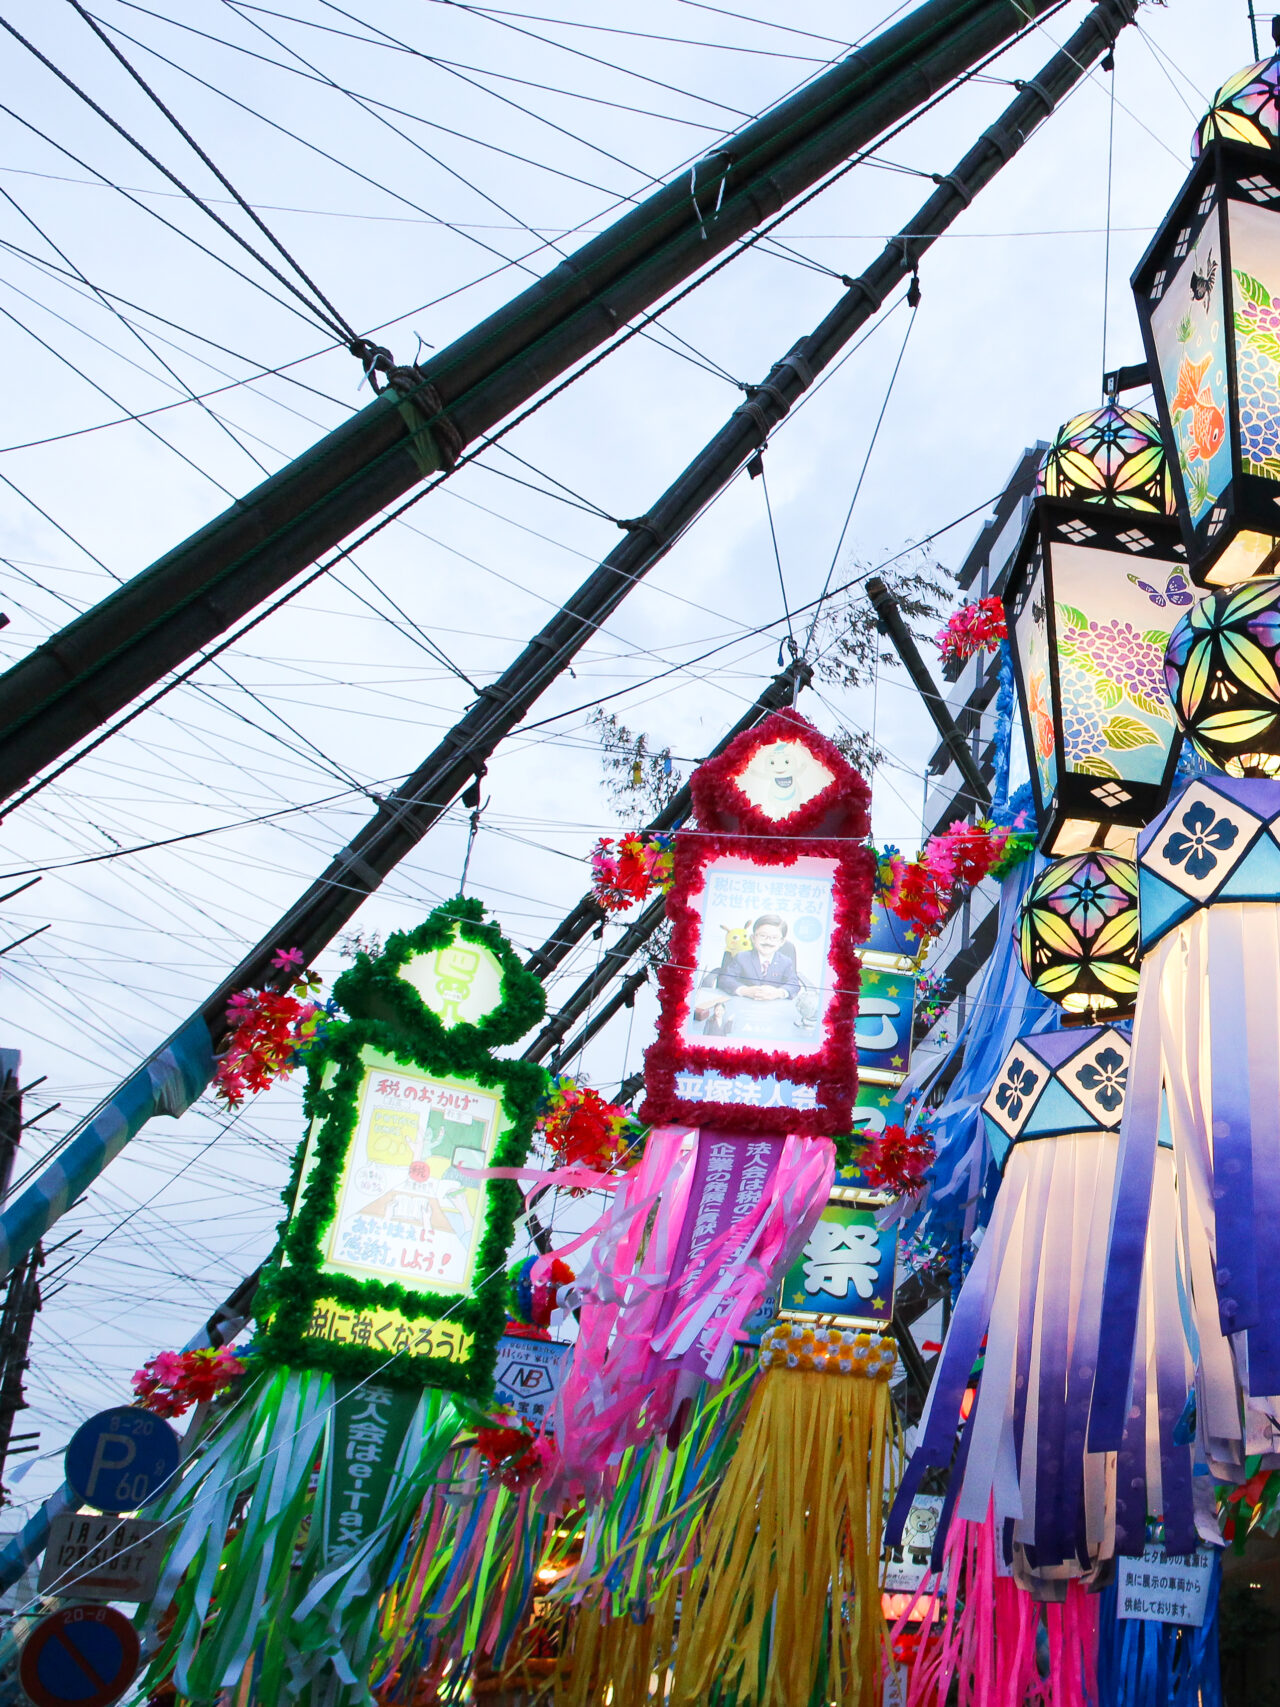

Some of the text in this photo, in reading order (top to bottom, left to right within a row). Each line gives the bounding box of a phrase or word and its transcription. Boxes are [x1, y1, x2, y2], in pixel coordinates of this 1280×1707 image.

[714, 876, 826, 898] 税に強い経営者が
[375, 1078, 479, 1111] 税のおかげ
[675, 1077, 817, 1111] 平塚法人会
[802, 1218, 882, 1299] 祭
[307, 1307, 465, 1363] 税に強くなろう!
[511, 1367, 544, 1388] NB
[110, 1415, 155, 1436] 8-20
[84, 1432, 137, 1498] P
[1125, 1573, 1201, 1594] 奥に展示の車両から
[63, 1606, 107, 1625] 20-8
[1124, 1597, 1191, 1619] 供給しております。
